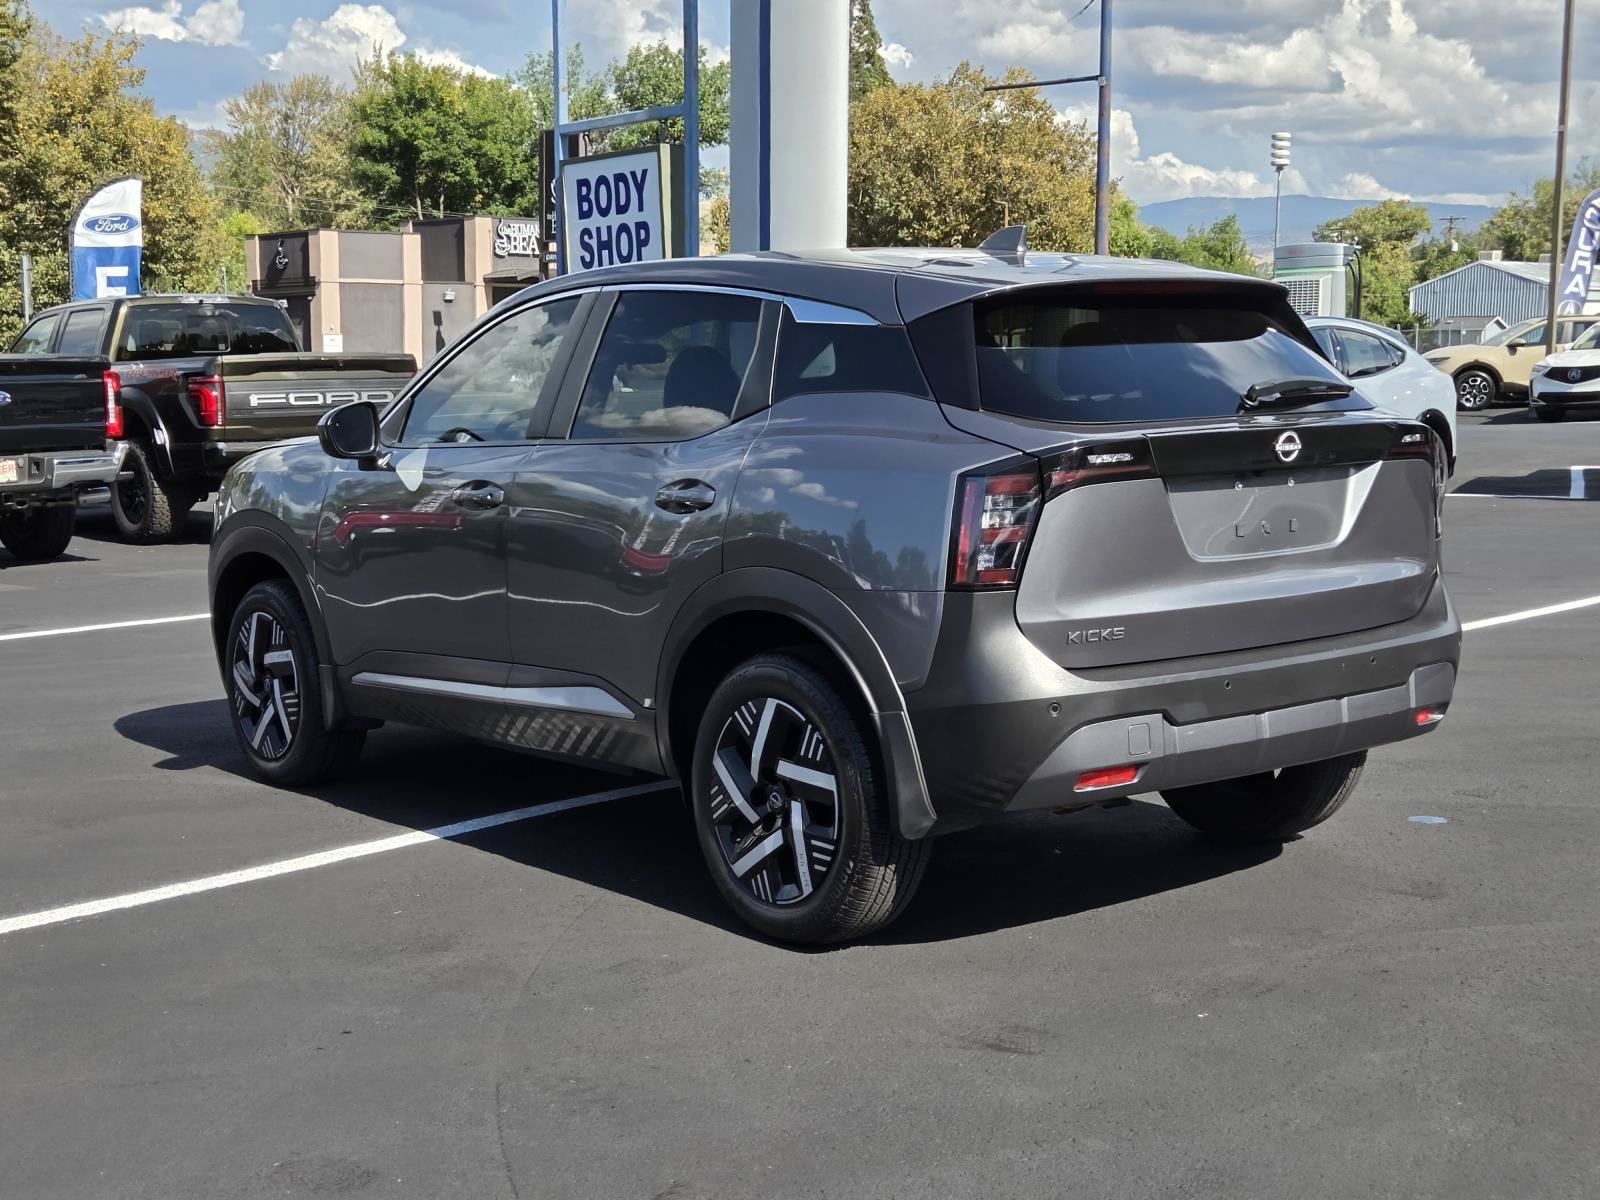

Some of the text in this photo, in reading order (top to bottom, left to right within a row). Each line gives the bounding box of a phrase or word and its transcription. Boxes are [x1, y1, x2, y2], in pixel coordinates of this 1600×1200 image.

[576, 168, 648, 220] BODY
[95, 216, 128, 232] Ford
[508, 235, 540, 254] BEA
[579, 220, 651, 270] SHOP
[249, 391, 396, 407] FORD
[1275, 442, 1302, 451] NISSAN
[1066, 626, 1126, 645] KICKS
